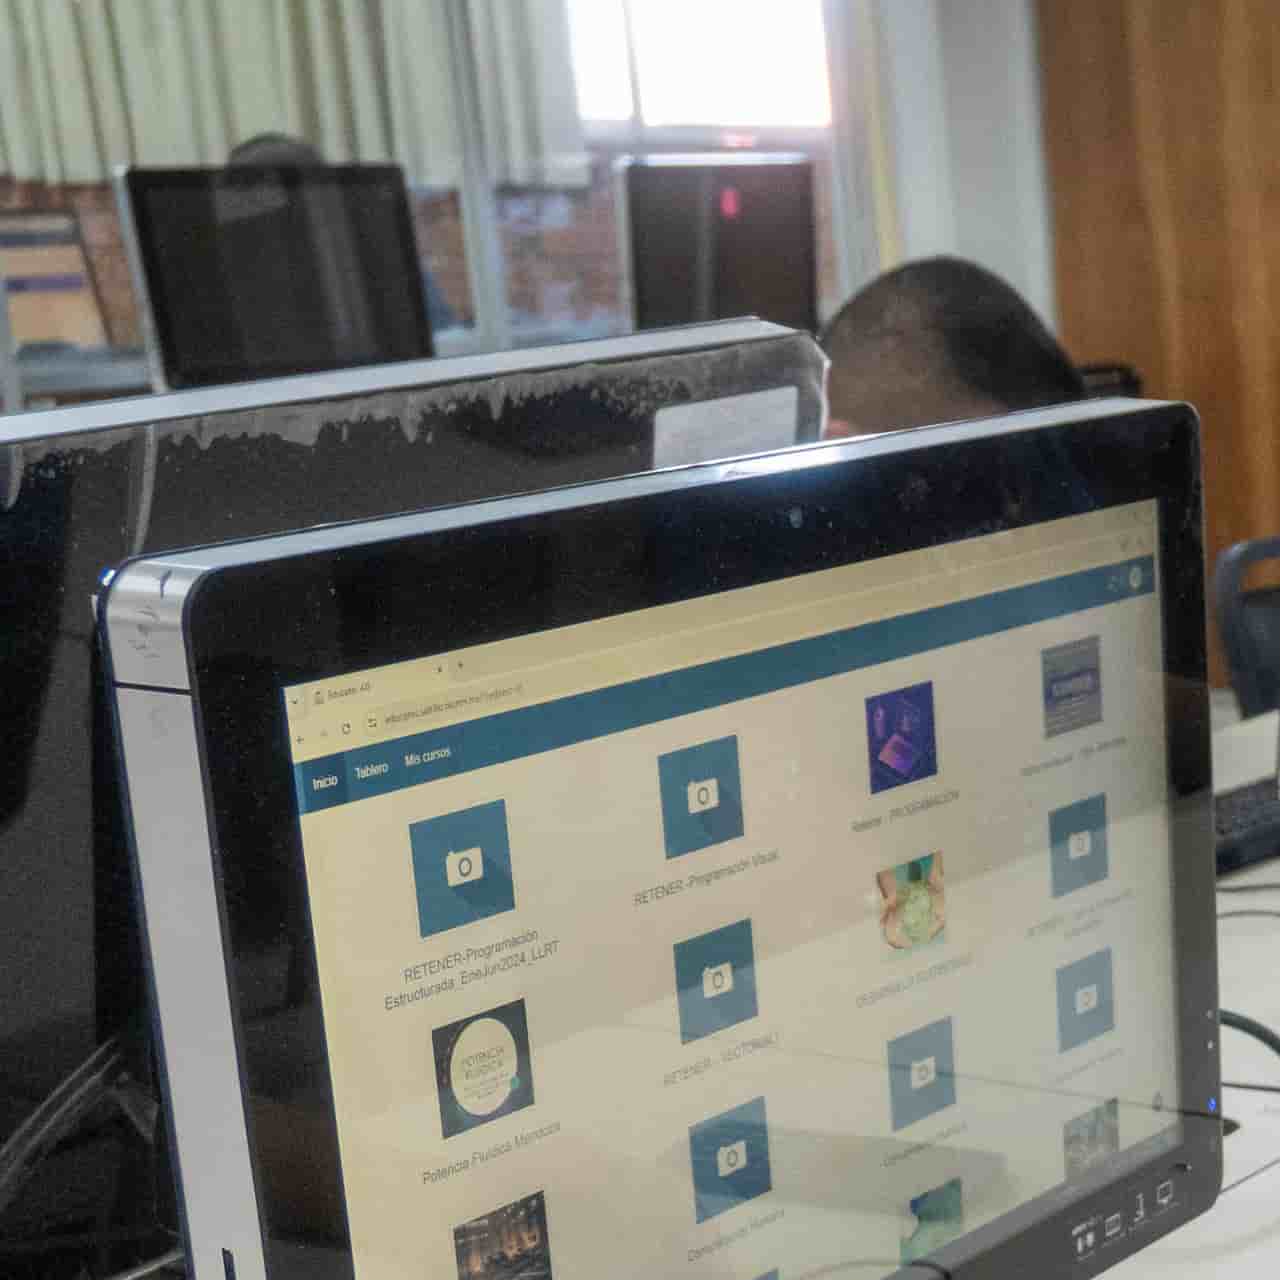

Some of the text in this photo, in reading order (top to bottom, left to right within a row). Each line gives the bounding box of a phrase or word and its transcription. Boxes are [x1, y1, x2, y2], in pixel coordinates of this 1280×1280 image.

[312, 748, 452, 791] Inicio Tablero Mis cursos
